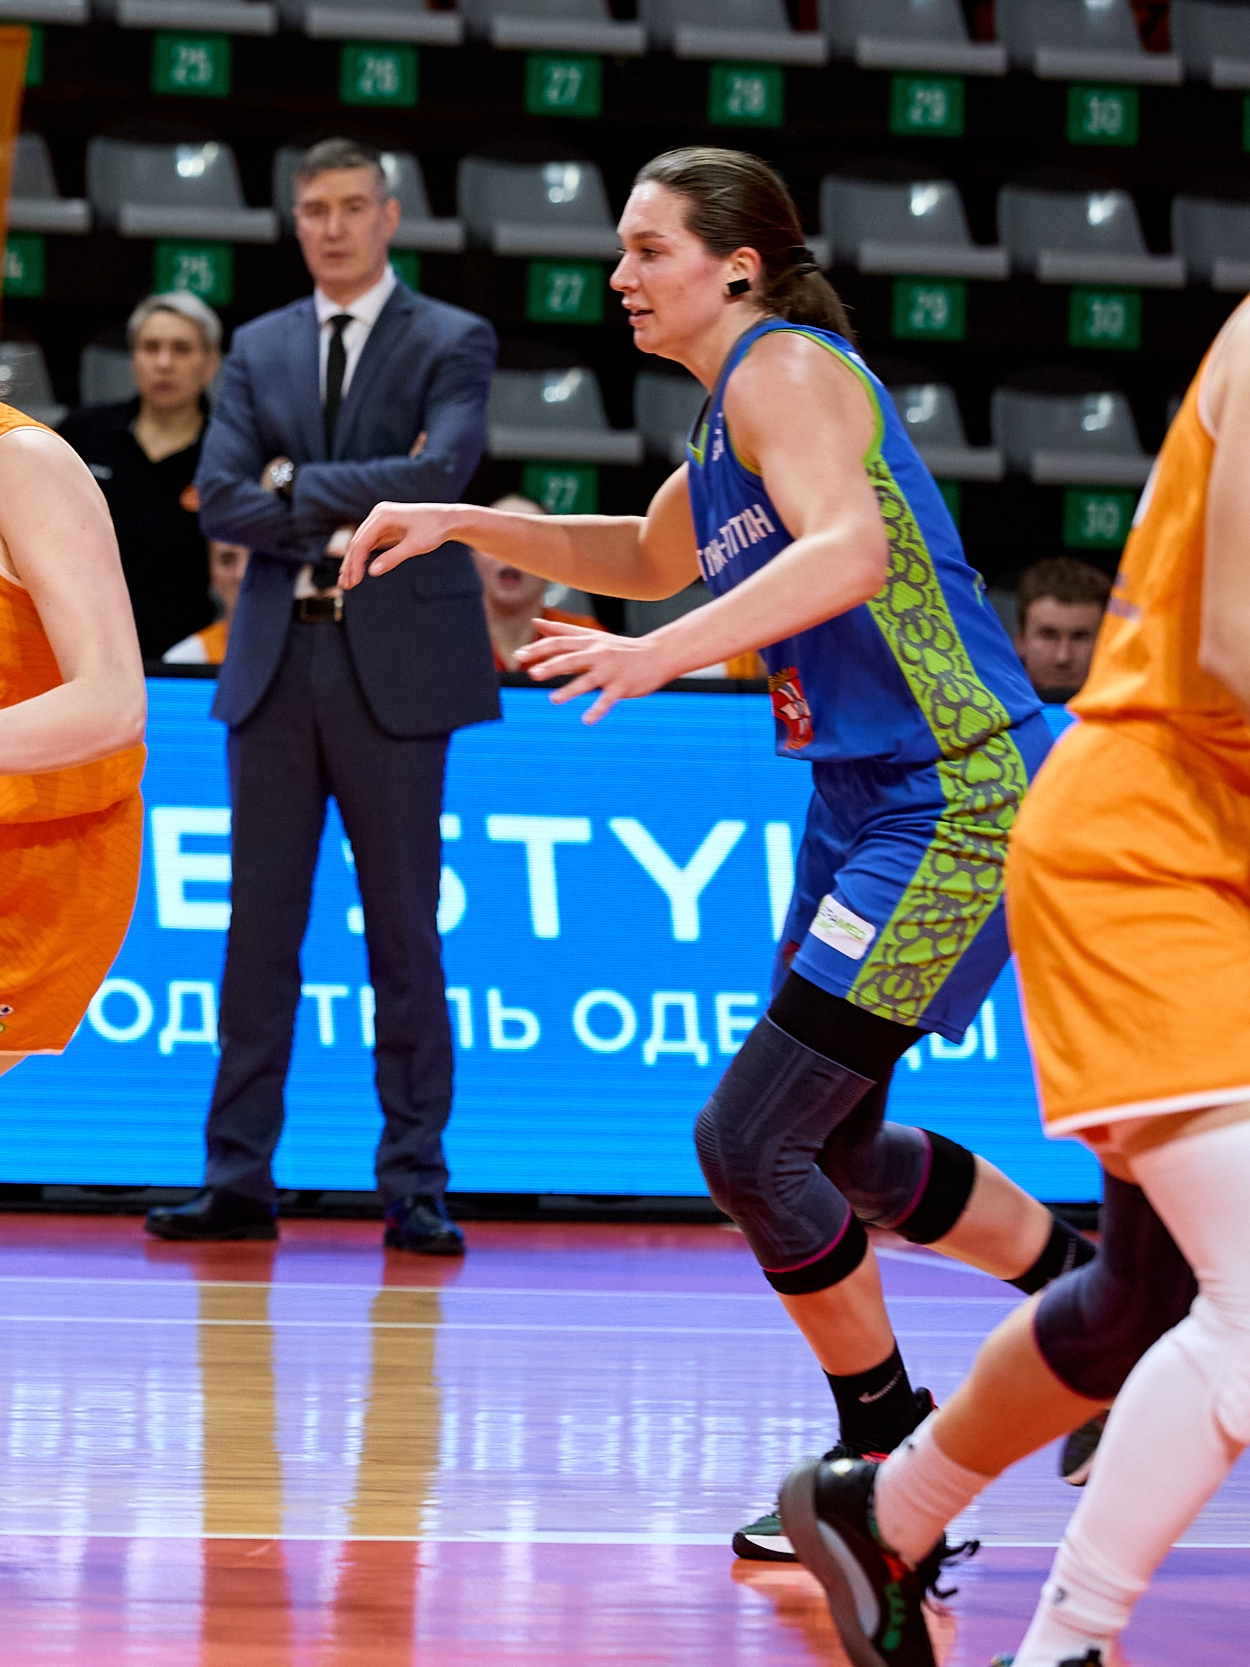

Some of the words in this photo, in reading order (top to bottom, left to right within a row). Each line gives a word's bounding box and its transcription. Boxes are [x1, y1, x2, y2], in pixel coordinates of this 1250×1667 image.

[173, 45, 213, 84] 25
[545, 66, 582, 104] 27
[727, 76, 766, 114] 28
[909, 87, 947, 124] 29
[1085, 95, 1123, 135] 30
[548, 272, 584, 311] 27
[911, 290, 949, 328] 29
[1088, 298, 1126, 337] 30
[1085, 498, 1121, 538] 30
